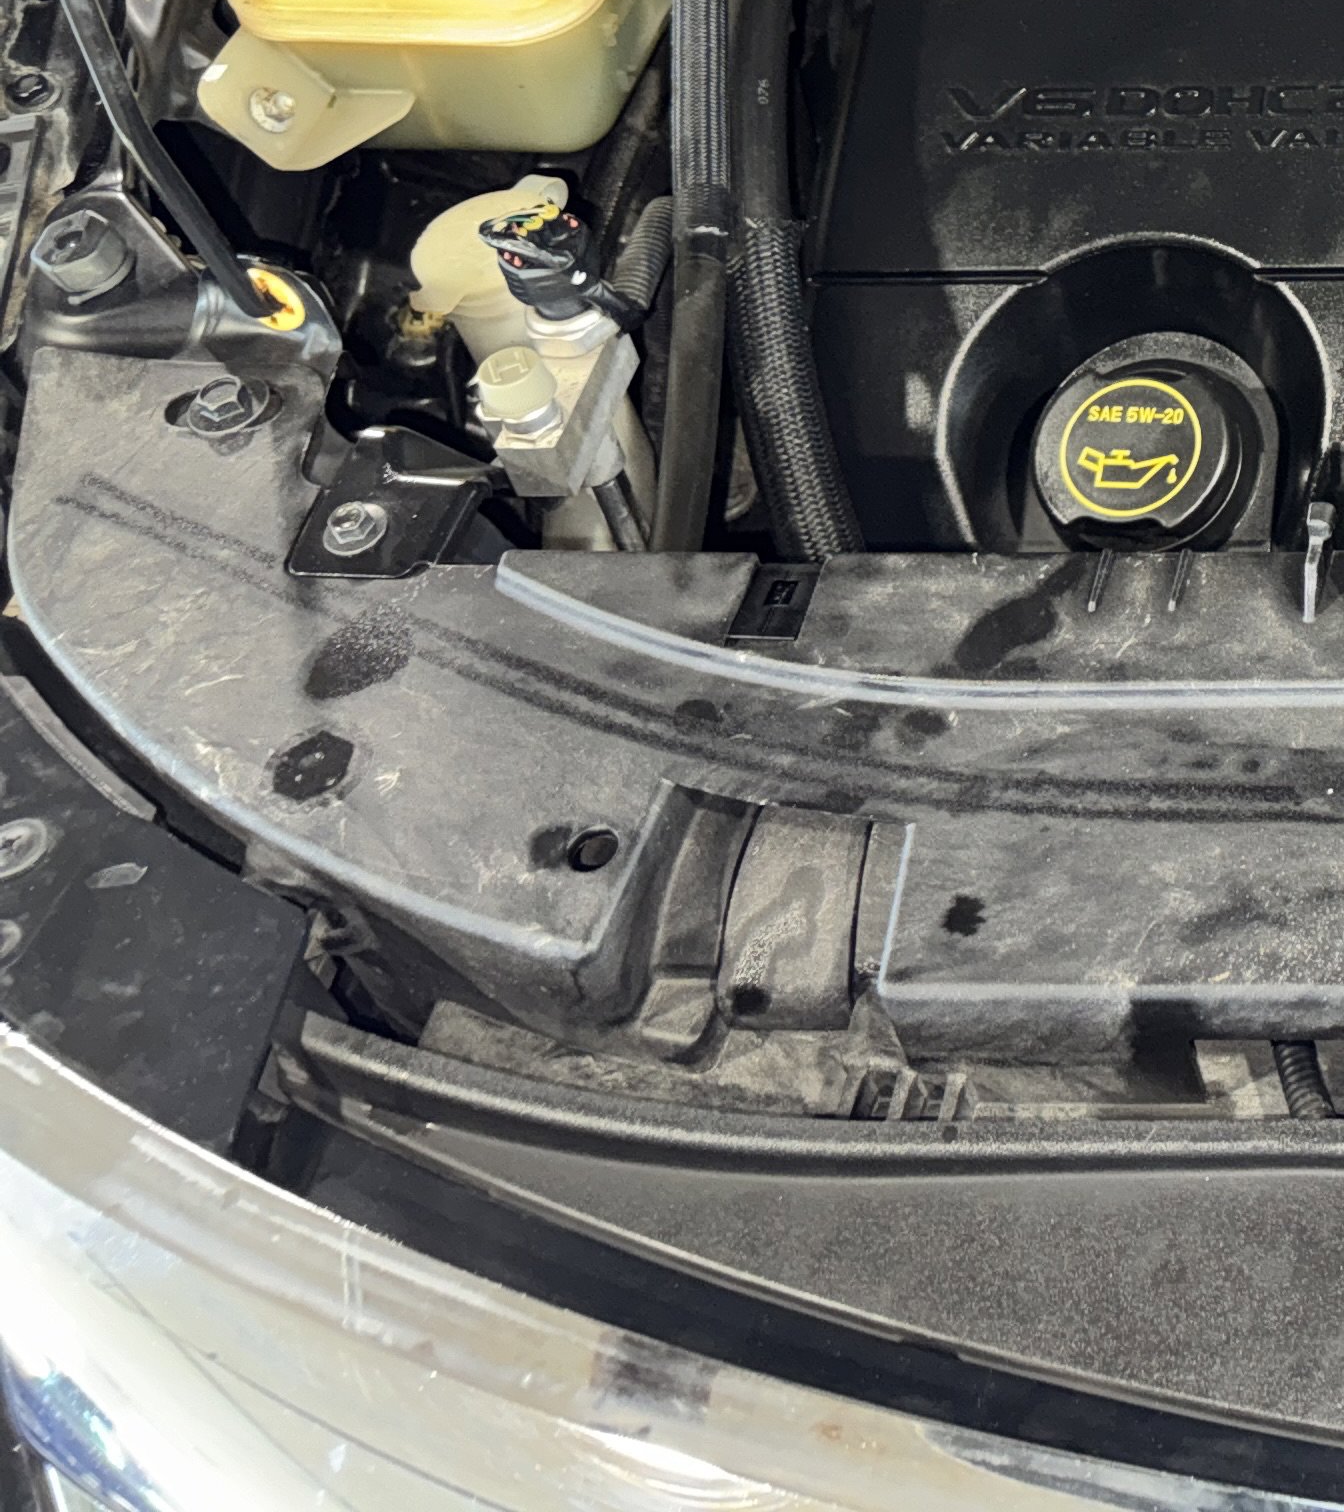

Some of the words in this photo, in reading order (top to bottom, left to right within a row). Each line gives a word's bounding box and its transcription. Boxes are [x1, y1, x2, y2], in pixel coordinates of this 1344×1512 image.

[944, 86, 1096, 121] V6
[1105, 85, 1314, 119] DOHC
[940, 128, 1231, 152] VARIABLE
[1087, 405, 1123, 423] SAE
[1125, 406, 1185, 425] 5W-20
